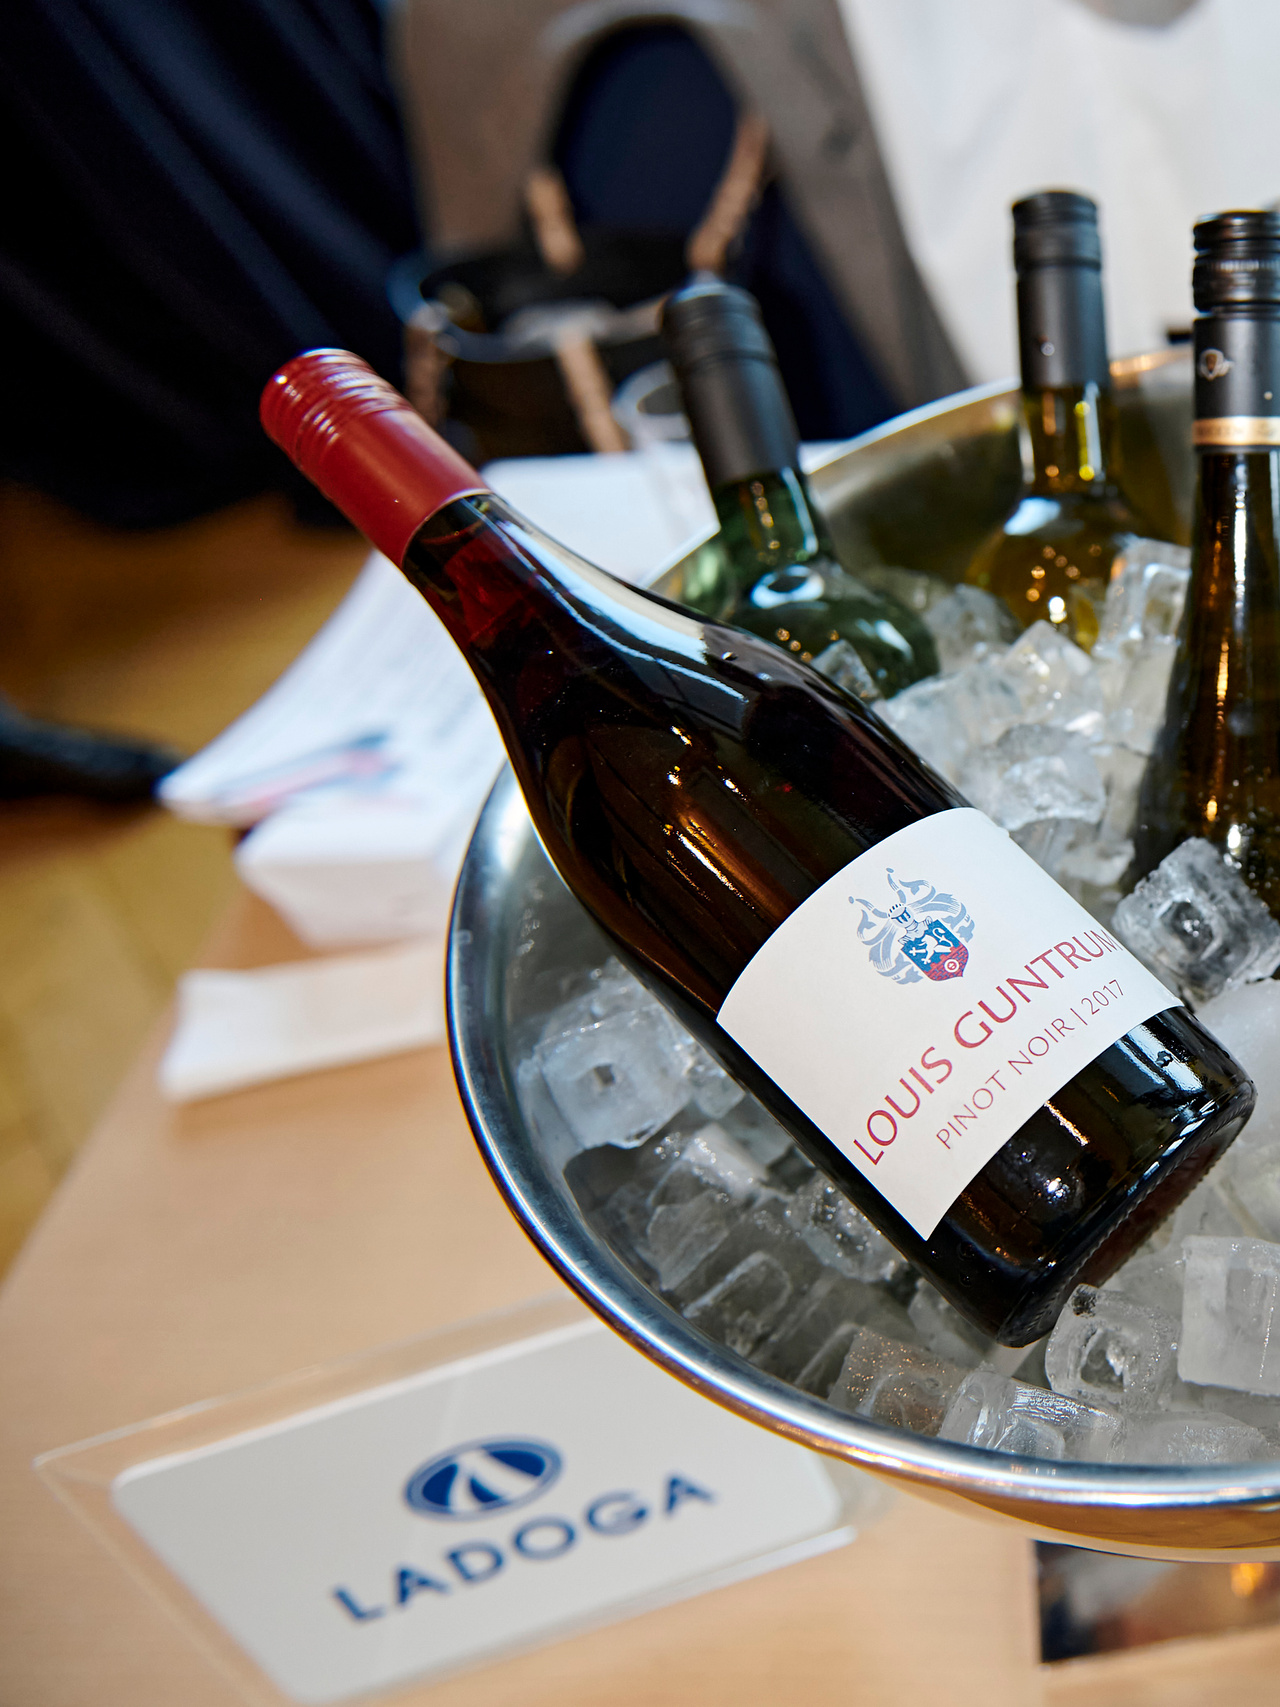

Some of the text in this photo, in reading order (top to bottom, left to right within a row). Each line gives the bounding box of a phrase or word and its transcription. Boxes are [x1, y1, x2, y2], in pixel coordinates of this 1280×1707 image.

[853, 929, 1124, 1166] LOUIS GUNTRUM
[936, 1069, 1007, 1150] PINOT
[1007, 1018, 1076, 1075] NOIR
[1080, 978, 1124, 1015] 2017
[331, 1470, 719, 1624] LADOGA
